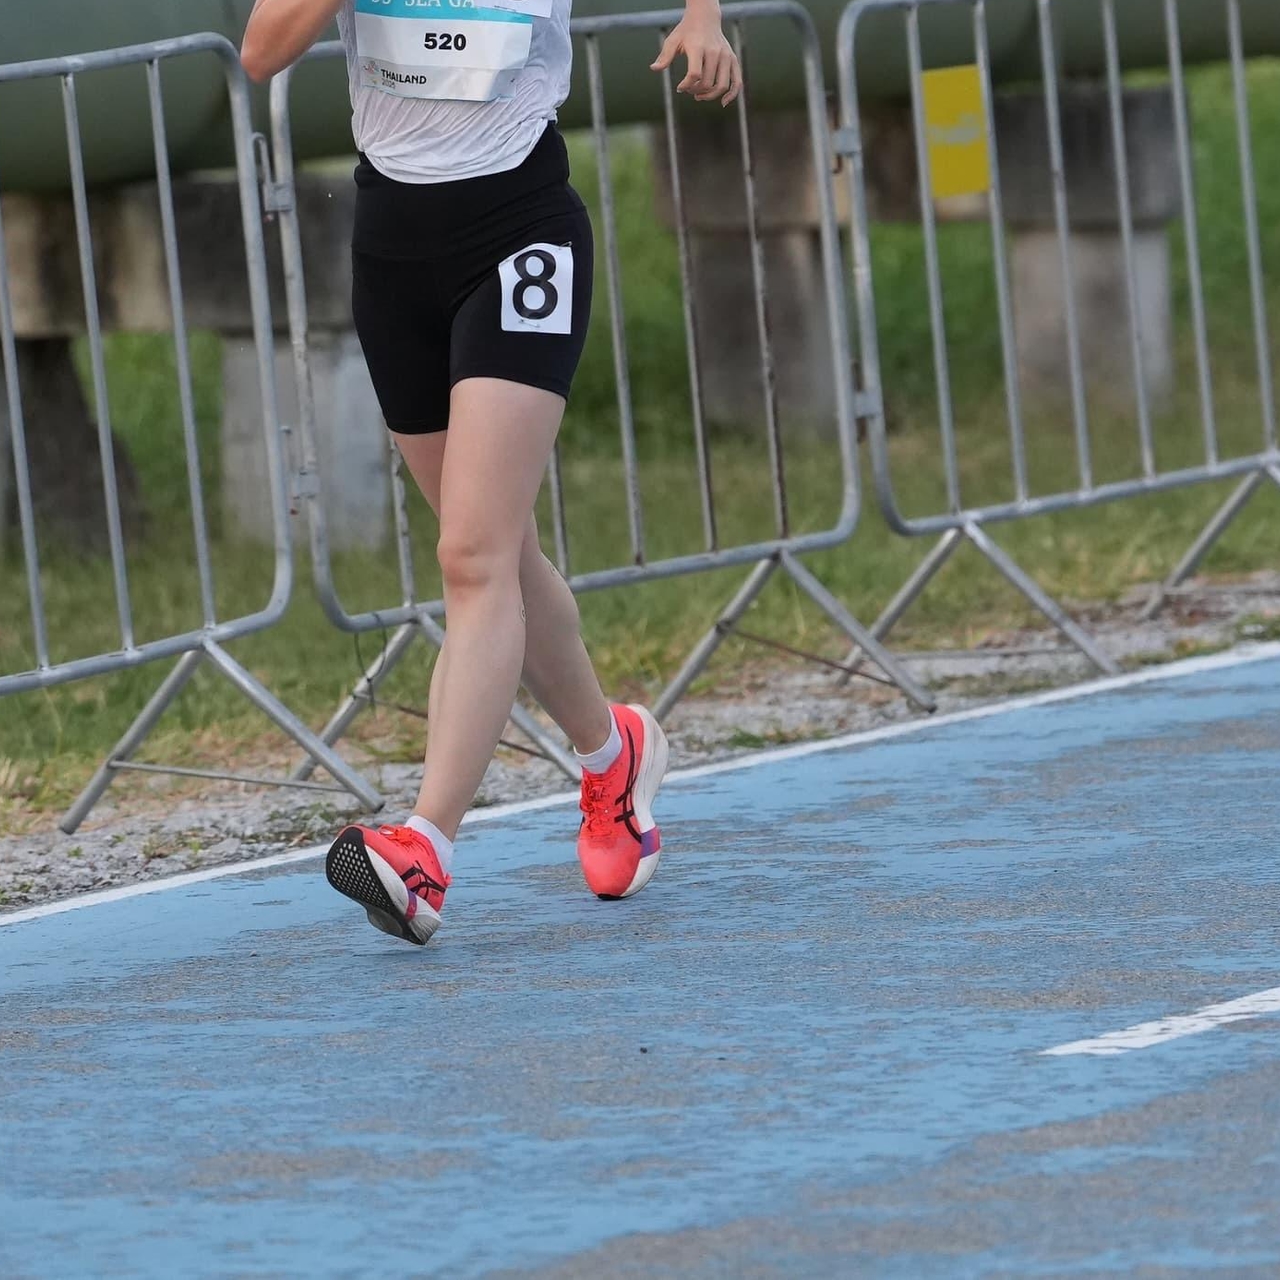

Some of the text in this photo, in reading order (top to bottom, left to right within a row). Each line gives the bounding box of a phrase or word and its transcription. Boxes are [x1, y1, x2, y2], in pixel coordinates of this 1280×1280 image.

[423, 32, 467, 51] 520
[380, 68, 427, 85] THAILAND
[512, 249, 558, 320] 8
